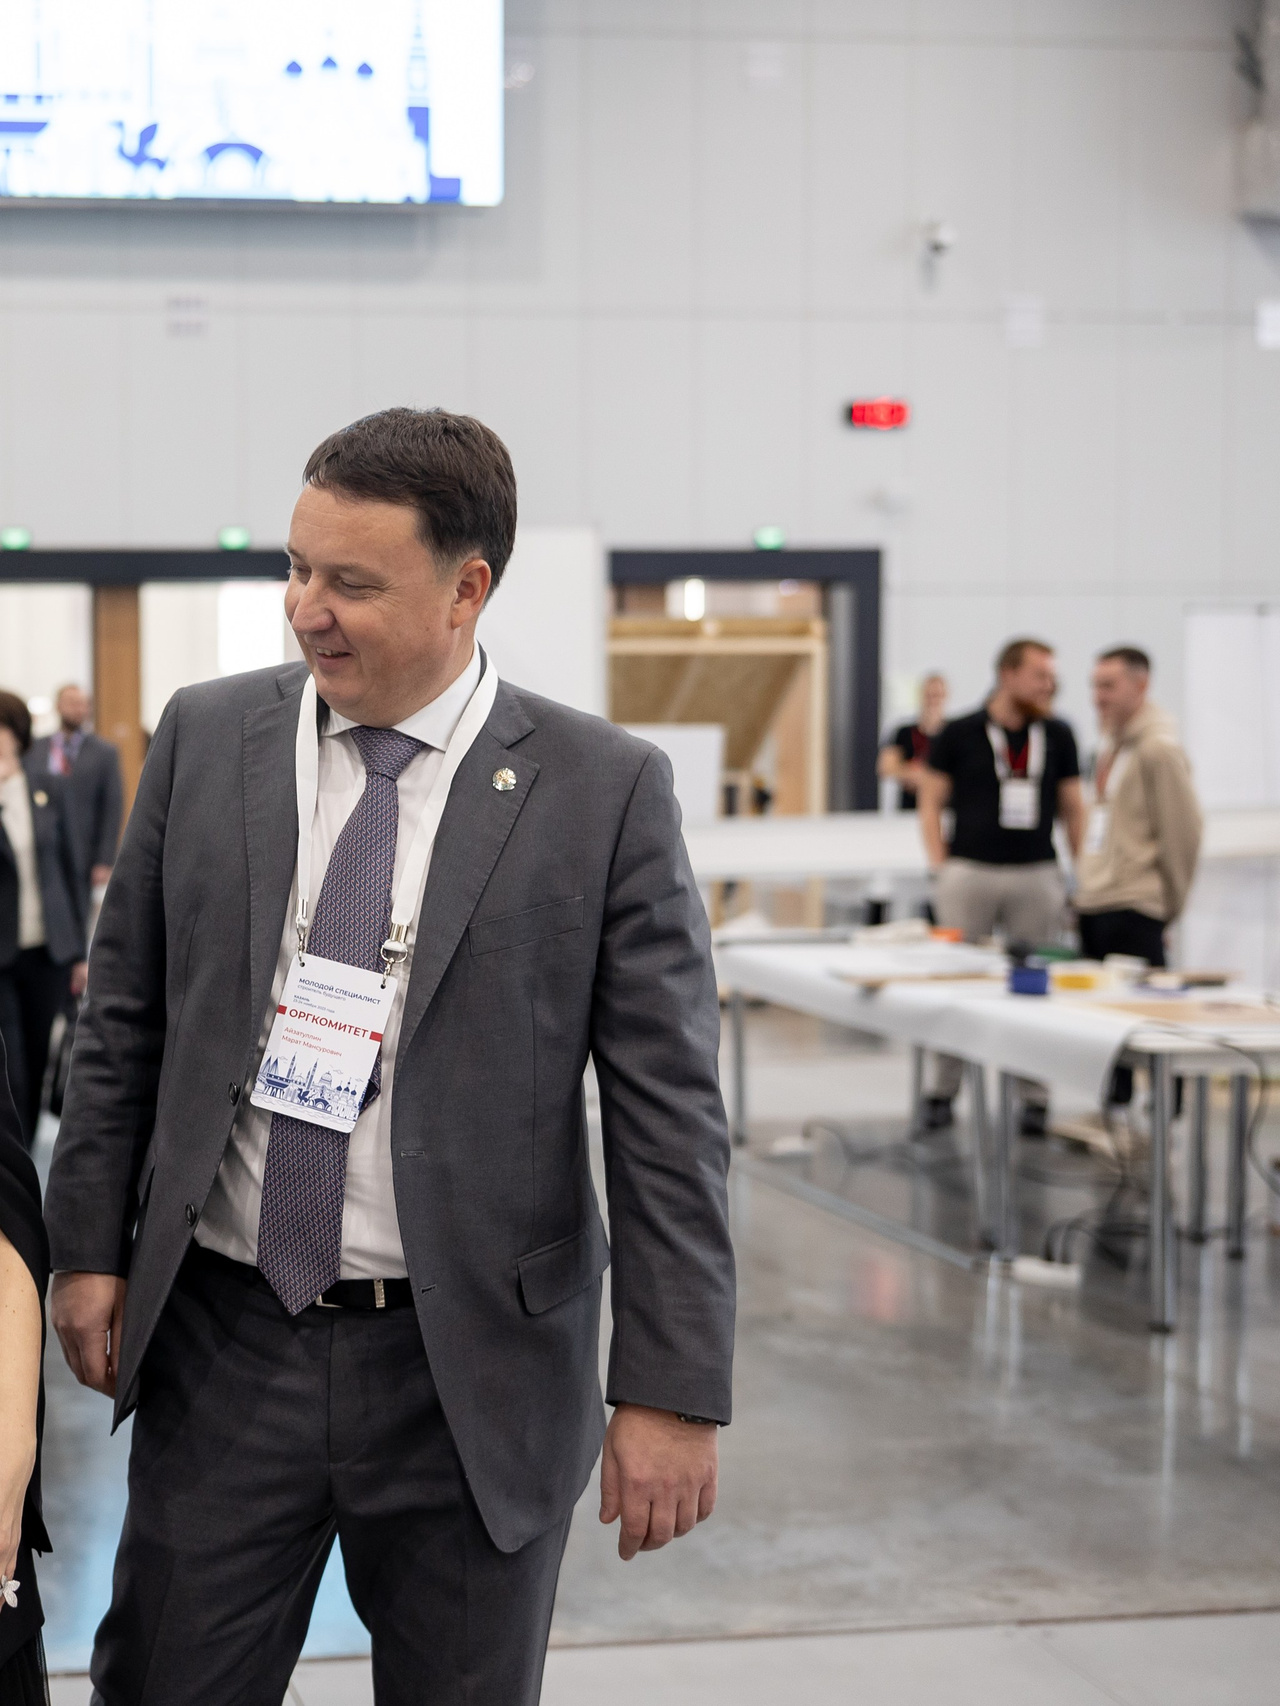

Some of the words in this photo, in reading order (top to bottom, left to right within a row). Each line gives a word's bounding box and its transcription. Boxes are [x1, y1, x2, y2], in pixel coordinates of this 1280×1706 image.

[299, 978, 334, 992] МОЛОДОЙ
[335, 987, 381, 1005] СПЕЦИАЛИСТ
[284, 1026, 322, 1042] Айзатуллин
[289, 1008, 369, 1038] ОРГКОМИТЕТ
[281, 1035, 301, 1046] Марат
[302, 1041, 343, 1057] Мансурович
